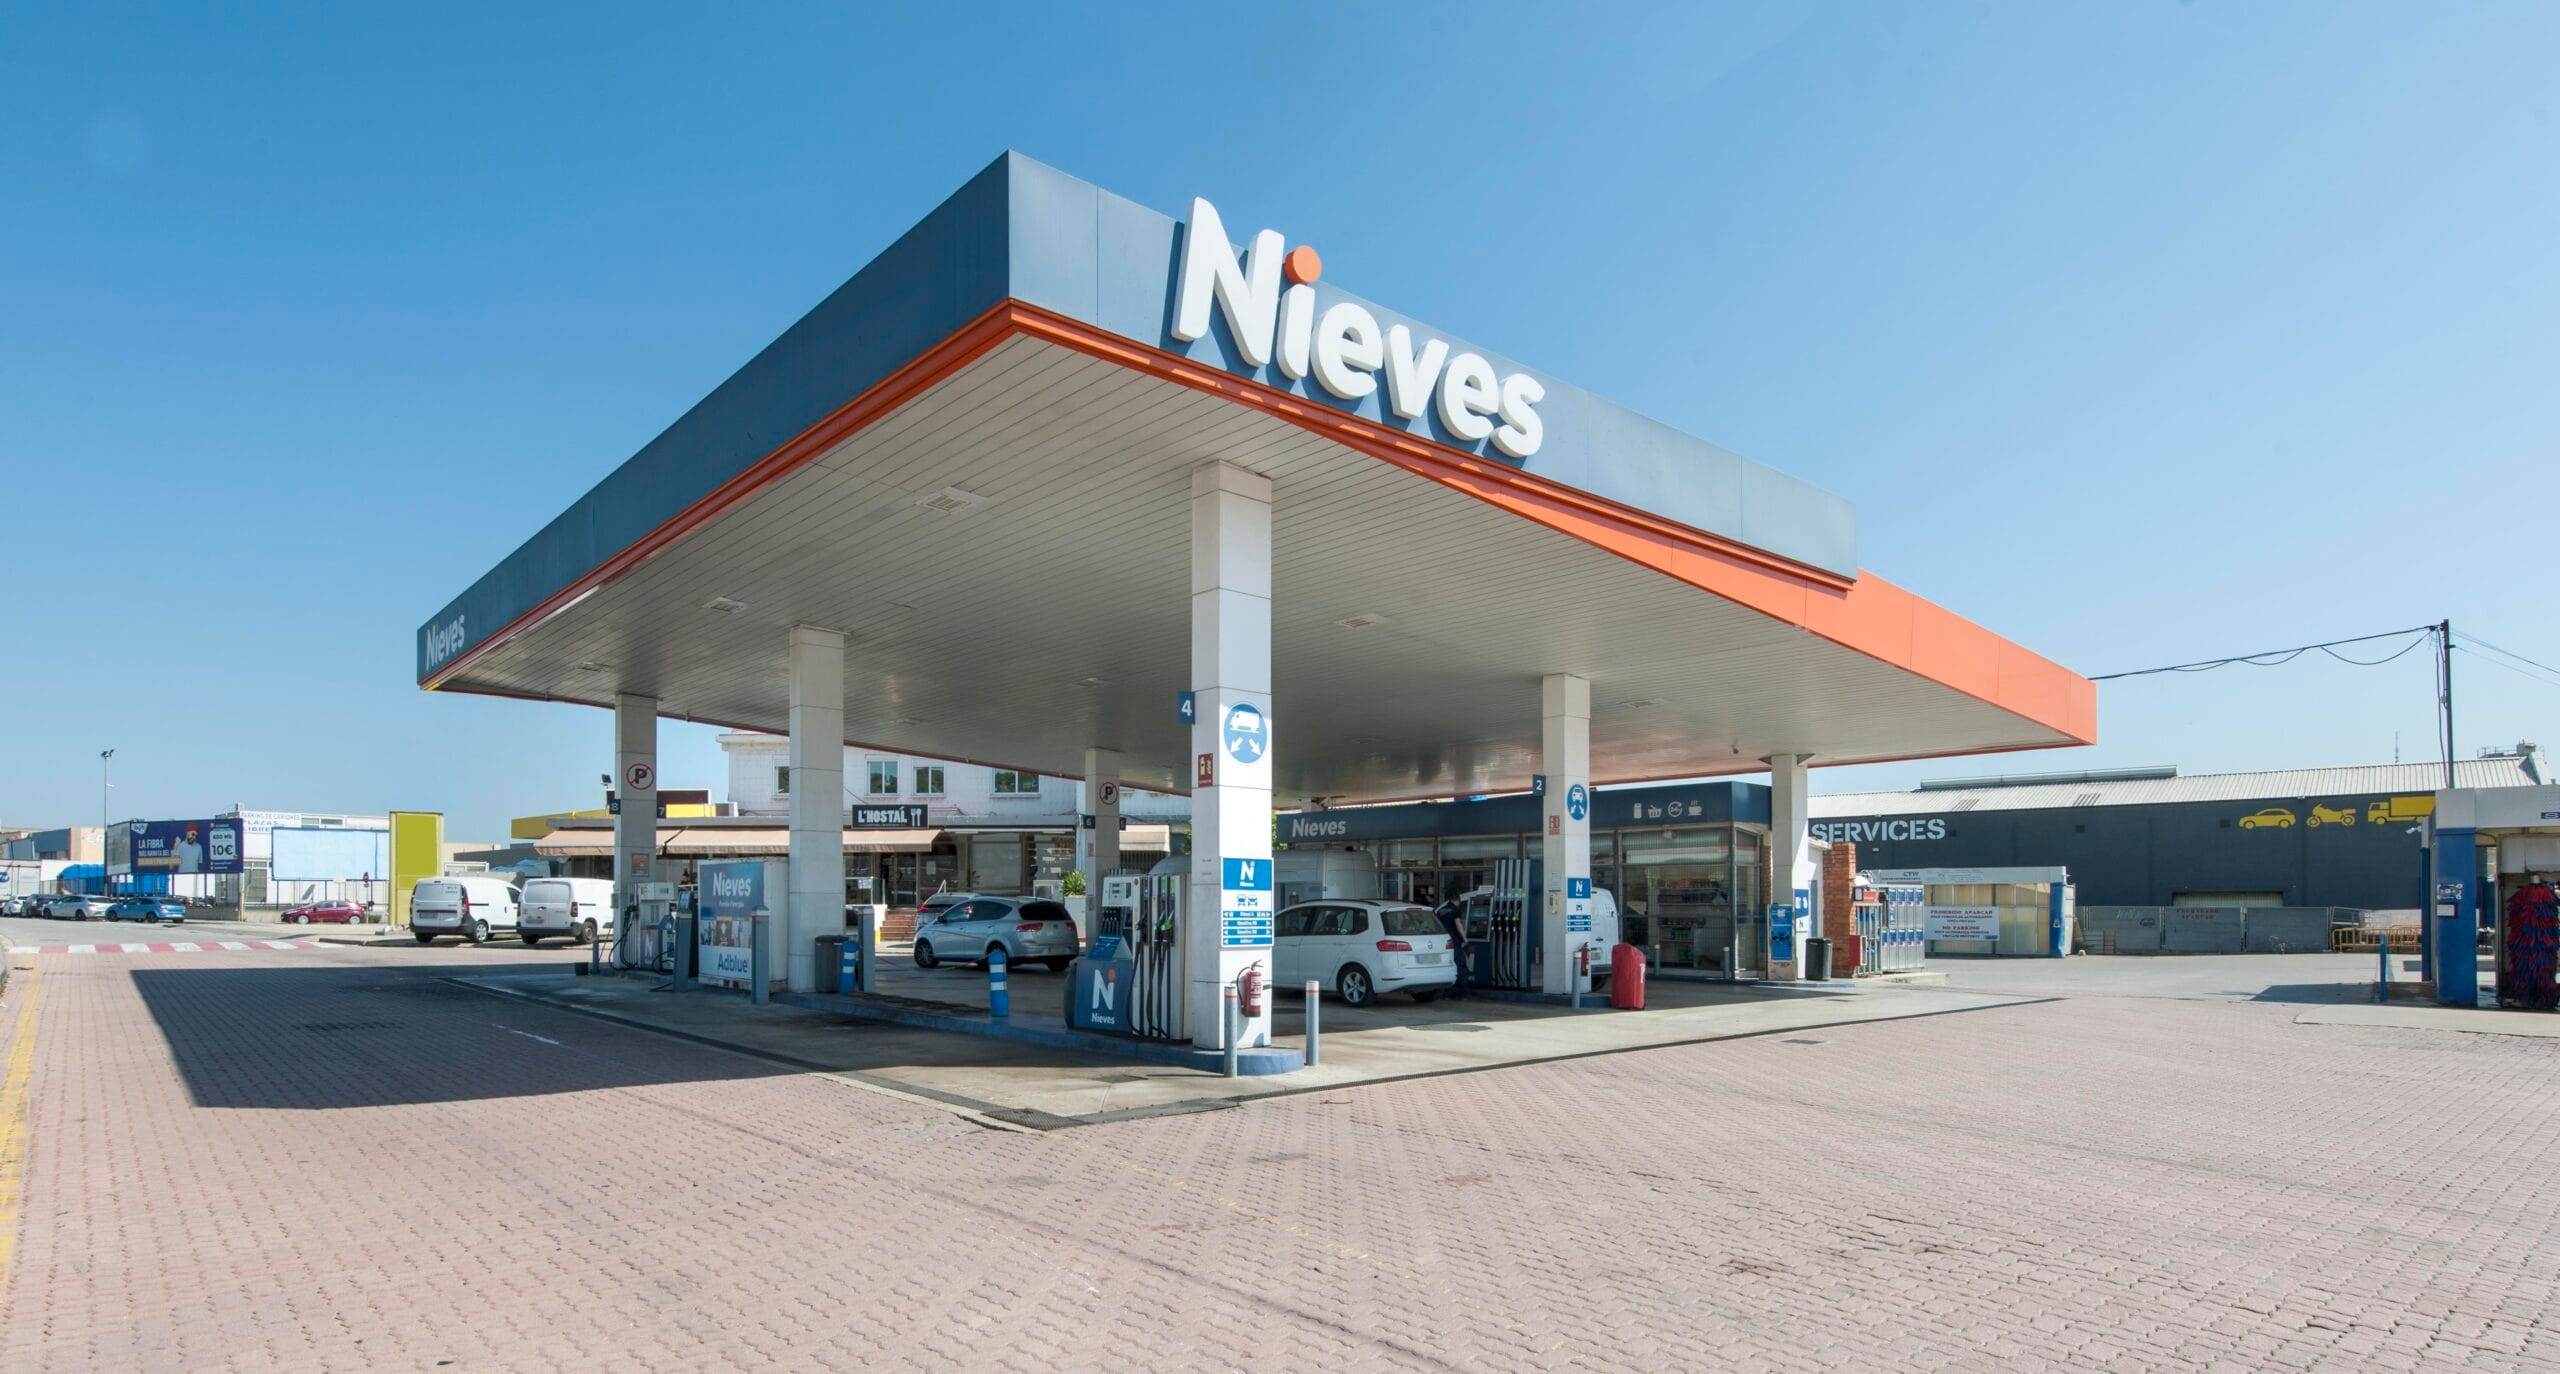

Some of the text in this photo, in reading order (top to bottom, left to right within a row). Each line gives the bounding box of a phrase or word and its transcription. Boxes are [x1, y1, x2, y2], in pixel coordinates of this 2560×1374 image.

[1171, 197, 1545, 458] Nieves
[426, 614, 465, 670] Nieves
[1181, 699, 1193, 717] 4
[1536, 780, 1543, 791] 2
[611, 802, 619, 812] 8
[658, 806, 665, 816] 7
[1292, 818, 1347, 838] Nieves
[1811, 818, 1946, 843] SERVICES
[138, 838, 164, 849] LA FIBRA
[212, 845, 233, 856] 10€
[1240, 860, 1255, 881] N
[713, 872, 752, 897] Nieves
[717, 953, 749, 973] Adblue
[1092, 968, 1116, 1010] N
[1091, 1012, 1116, 1025] Nieves
